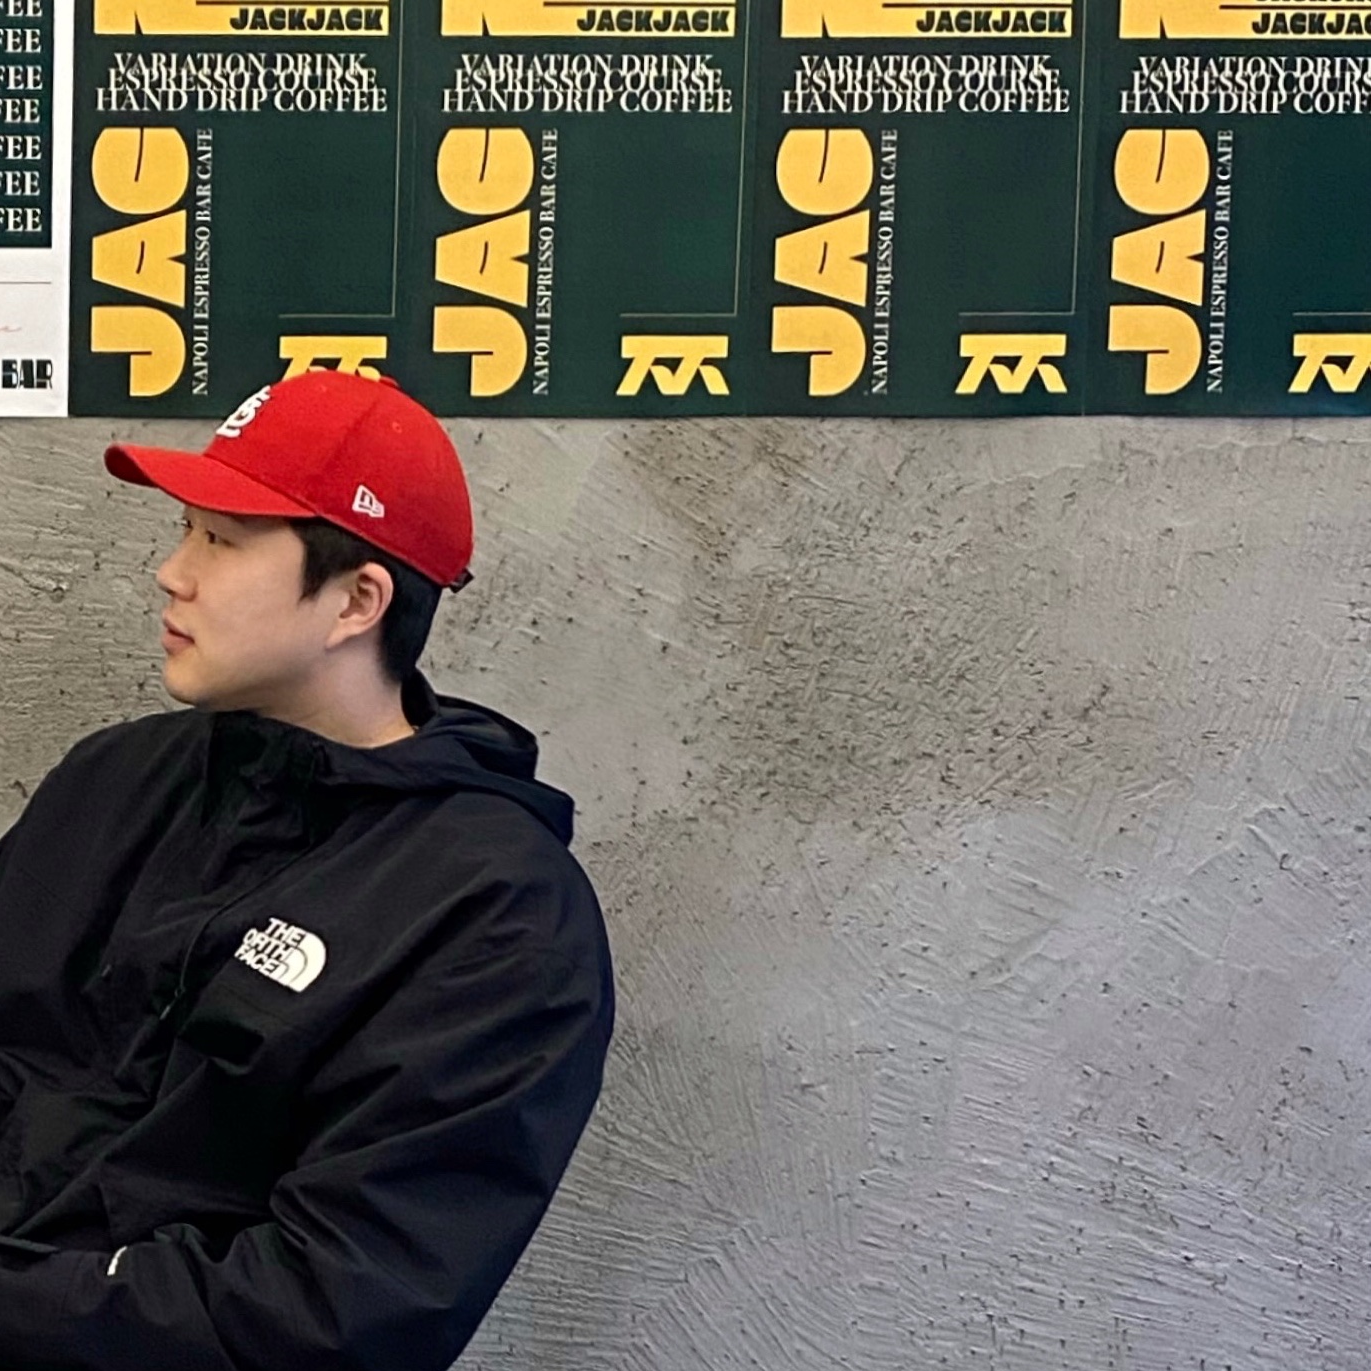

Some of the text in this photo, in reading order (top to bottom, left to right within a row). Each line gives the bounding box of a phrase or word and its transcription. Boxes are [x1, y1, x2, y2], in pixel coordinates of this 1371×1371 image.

[230, 8, 383, 31] JACKJACK
[577, 9, 729, 33] JACKJACK
[916, 10, 1066, 33] JACKJACK
[1252, 12, 1371, 34] JACKJA
[115, 52, 367, 75] VARIATION DRINK
[461, 54, 713, 76] VARIATION DRINK
[800, 55, 1051, 77] VARIATION DRINK
[1139, 56, 1371, 78] VARIATION DRIN
[108, 68, 377, 92] ESPRESSO COURSE
[455, 69, 722, 93] ESPRESSO COURSE
[794, 70, 1060, 93] ESPRESSO COURSE
[1132, 70, 1371, 94] ESPRESSO COURS
[96, 88, 387, 112] HAND DRIP COFFEE
[441, 89, 732, 113] HAND DRIP COFFEE
[782, 89, 1070, 113] HAND DRIP COFFEE
[1120, 90, 1371, 114] HAND DRIP COFF
[192, 128, 213, 395] NAPOLI ESPRESSO BAR CAFE
[533, 128, 558, 395] NAPOLI ESPRESSO BAR CAFE
[871, 129, 898, 394] NAPOLI ESPRESSO BAR CAFE
[1207, 129, 1233, 393] NAPOLI ESPRESSO BAR CAFE
[2, 360, 52, 389] BAR
[264, 917, 307, 947] THE
[242, 928, 294, 962] ORTH
[234, 943, 280, 978] FACE
